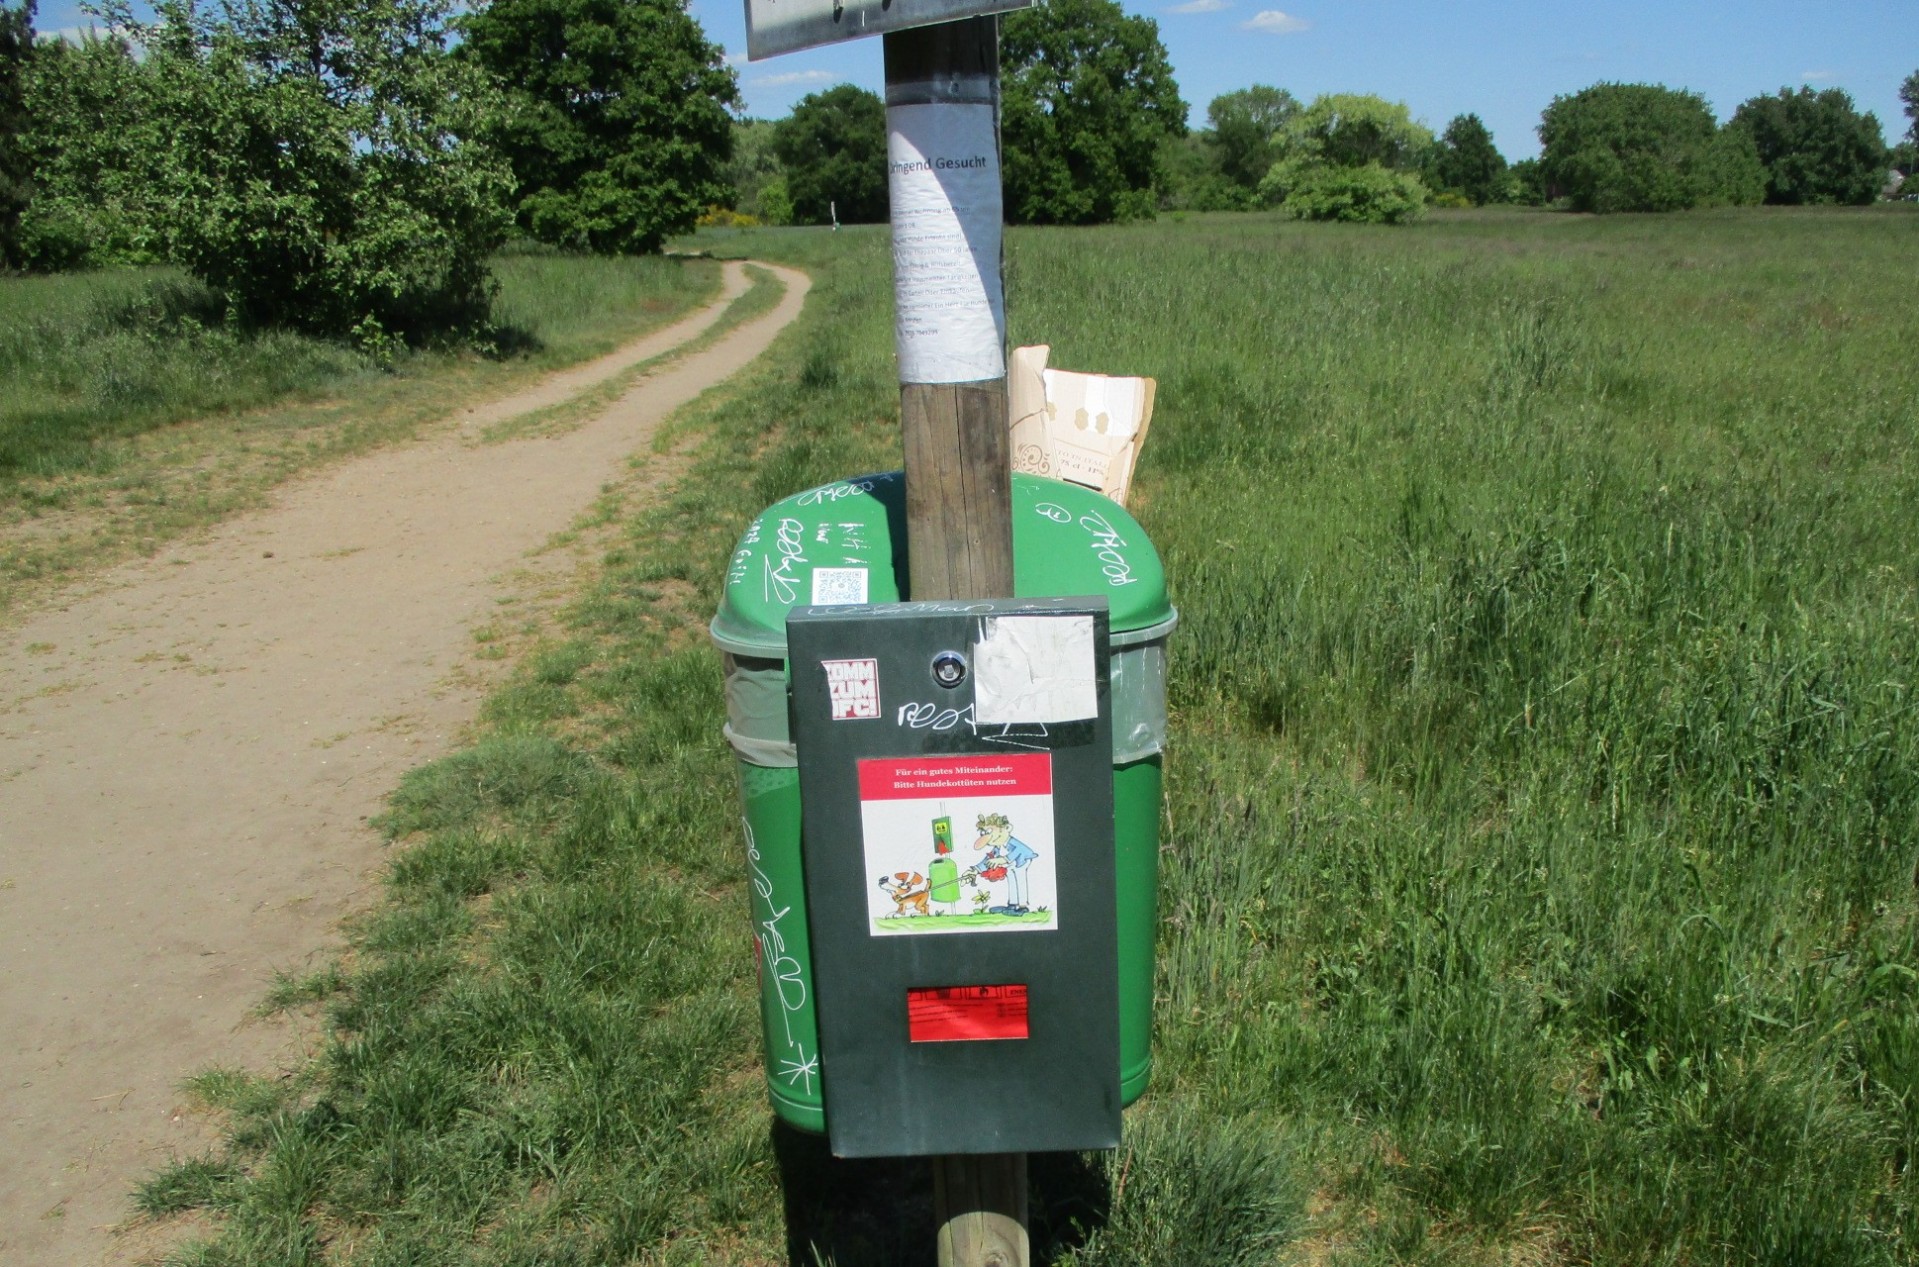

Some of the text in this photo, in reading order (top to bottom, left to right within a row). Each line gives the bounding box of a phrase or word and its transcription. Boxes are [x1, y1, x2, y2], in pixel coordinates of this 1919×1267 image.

[936, 156, 985, 170] Gesucht
[895, 764, 1014, 777] Für ein gutes Miteinander:
[893, 777, 1017, 789] Bitte Hundekottüten nutzen
